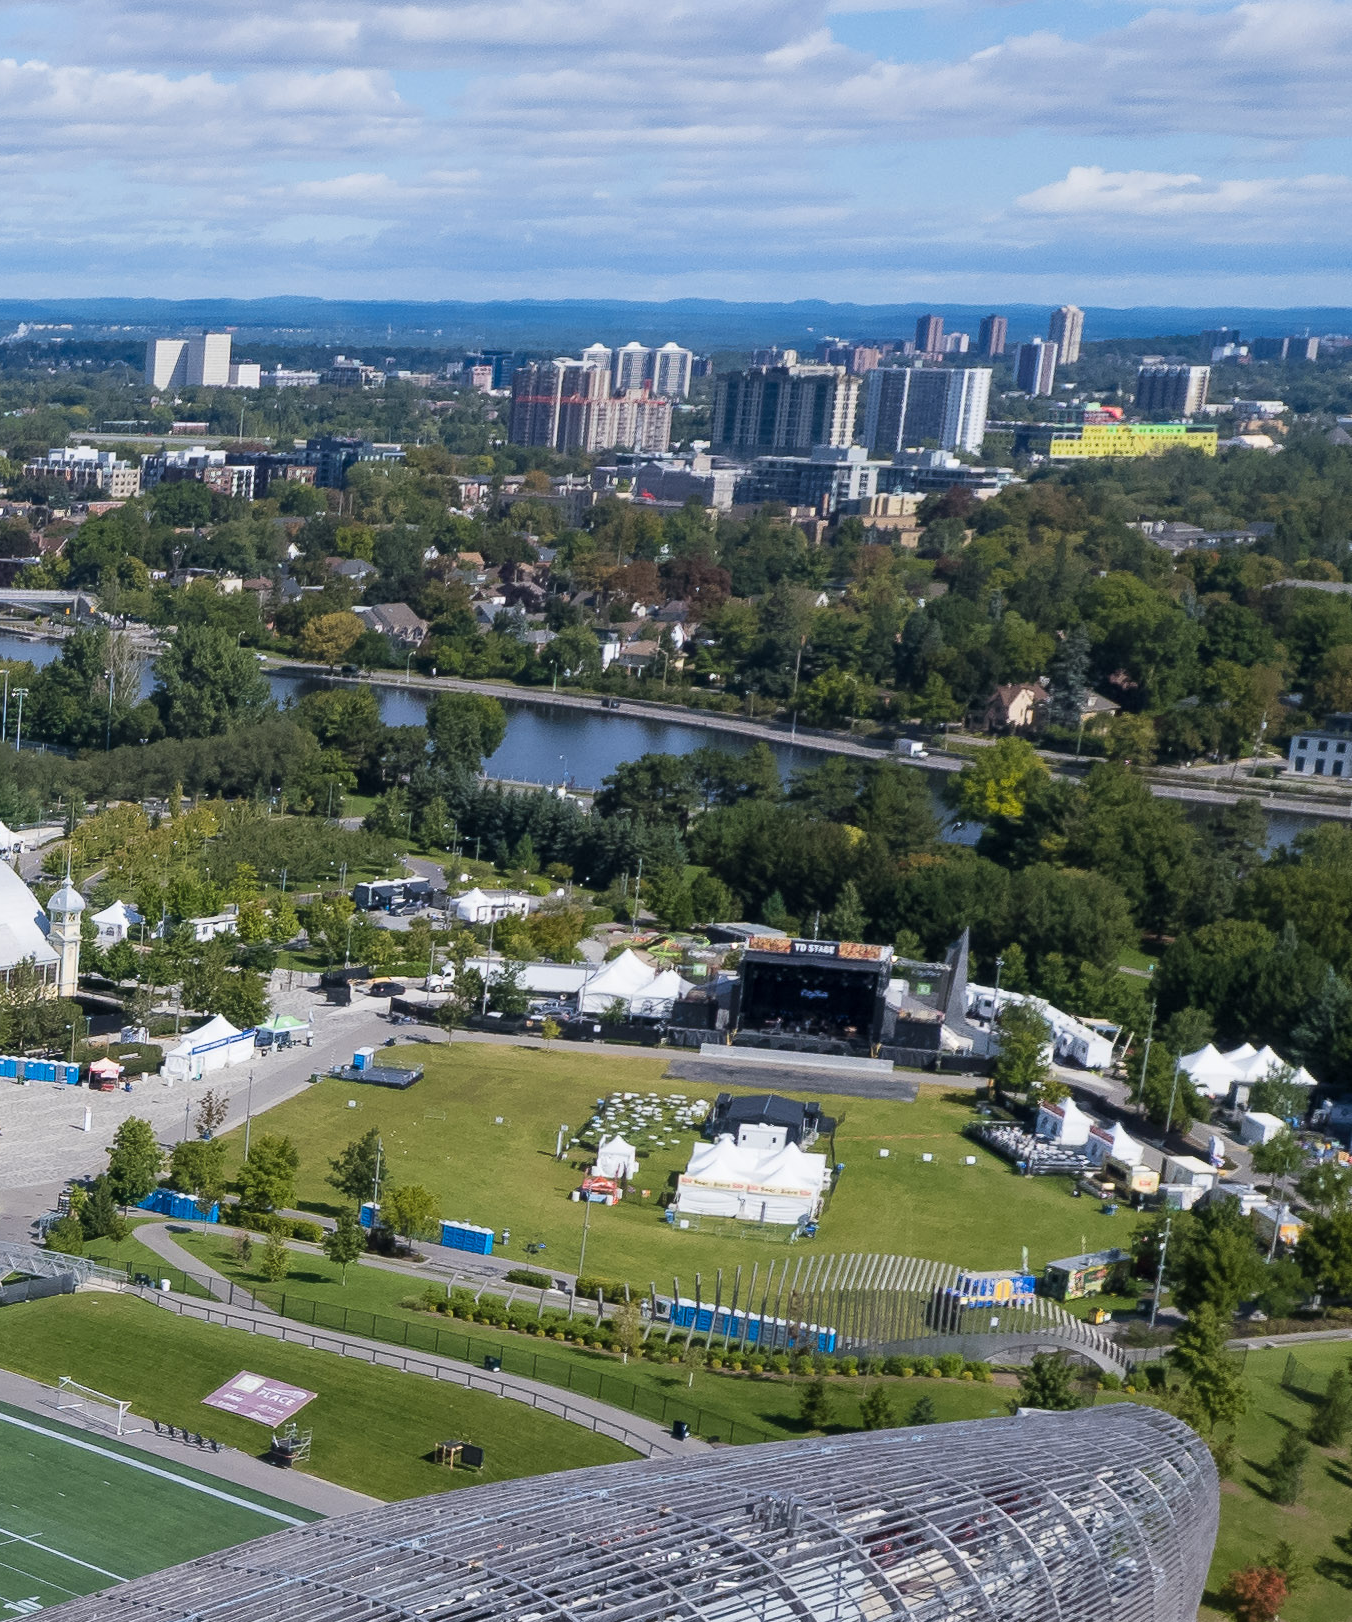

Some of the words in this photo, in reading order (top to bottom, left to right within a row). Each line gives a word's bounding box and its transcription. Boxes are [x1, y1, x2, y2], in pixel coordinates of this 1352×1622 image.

[794, 943, 807, 952] TD
[807, 944, 835, 955] STAGE
[256, 1390, 296, 1407] PLACE
[3, 1600, 44, 1614] 10
